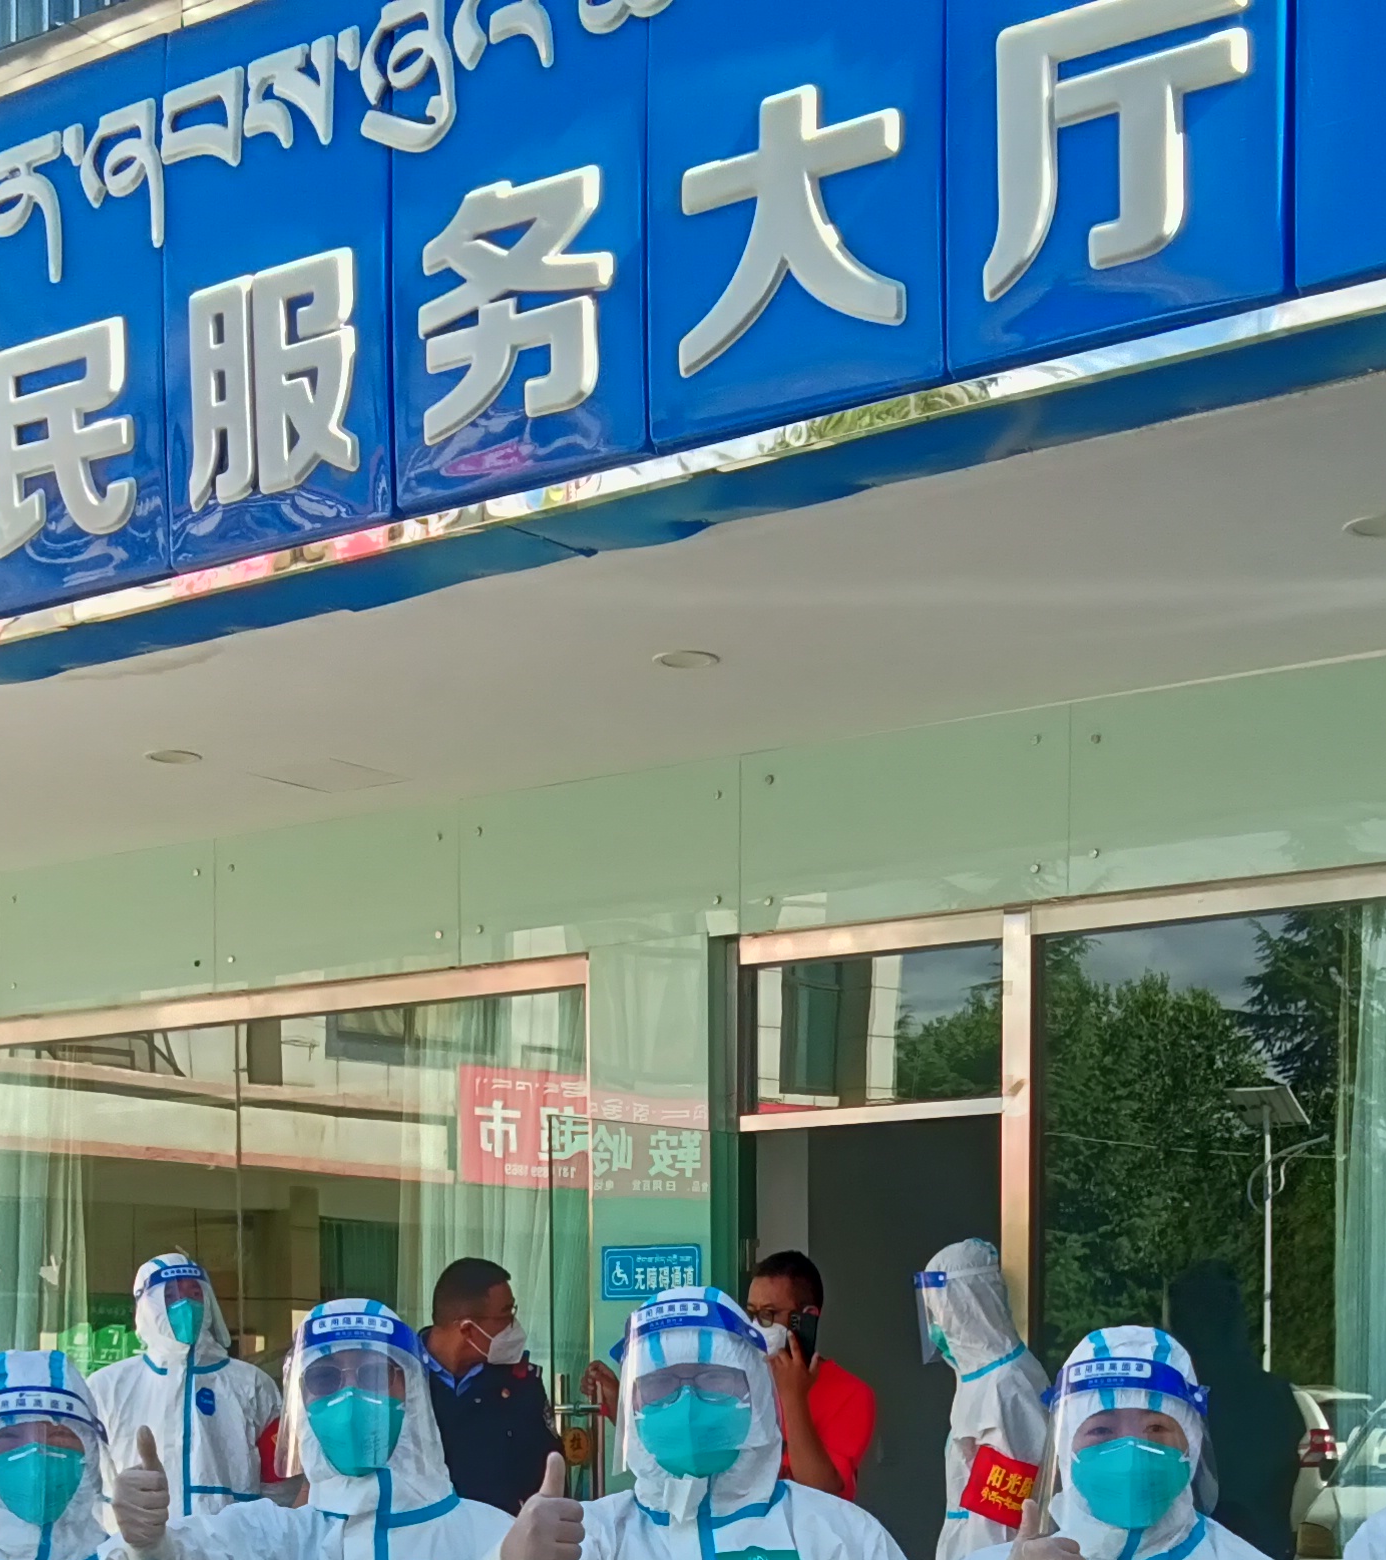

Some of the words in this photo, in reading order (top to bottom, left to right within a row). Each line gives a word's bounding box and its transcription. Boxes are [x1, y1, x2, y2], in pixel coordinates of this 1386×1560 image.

[635, 1266, 694, 1290] 无障碍通道
